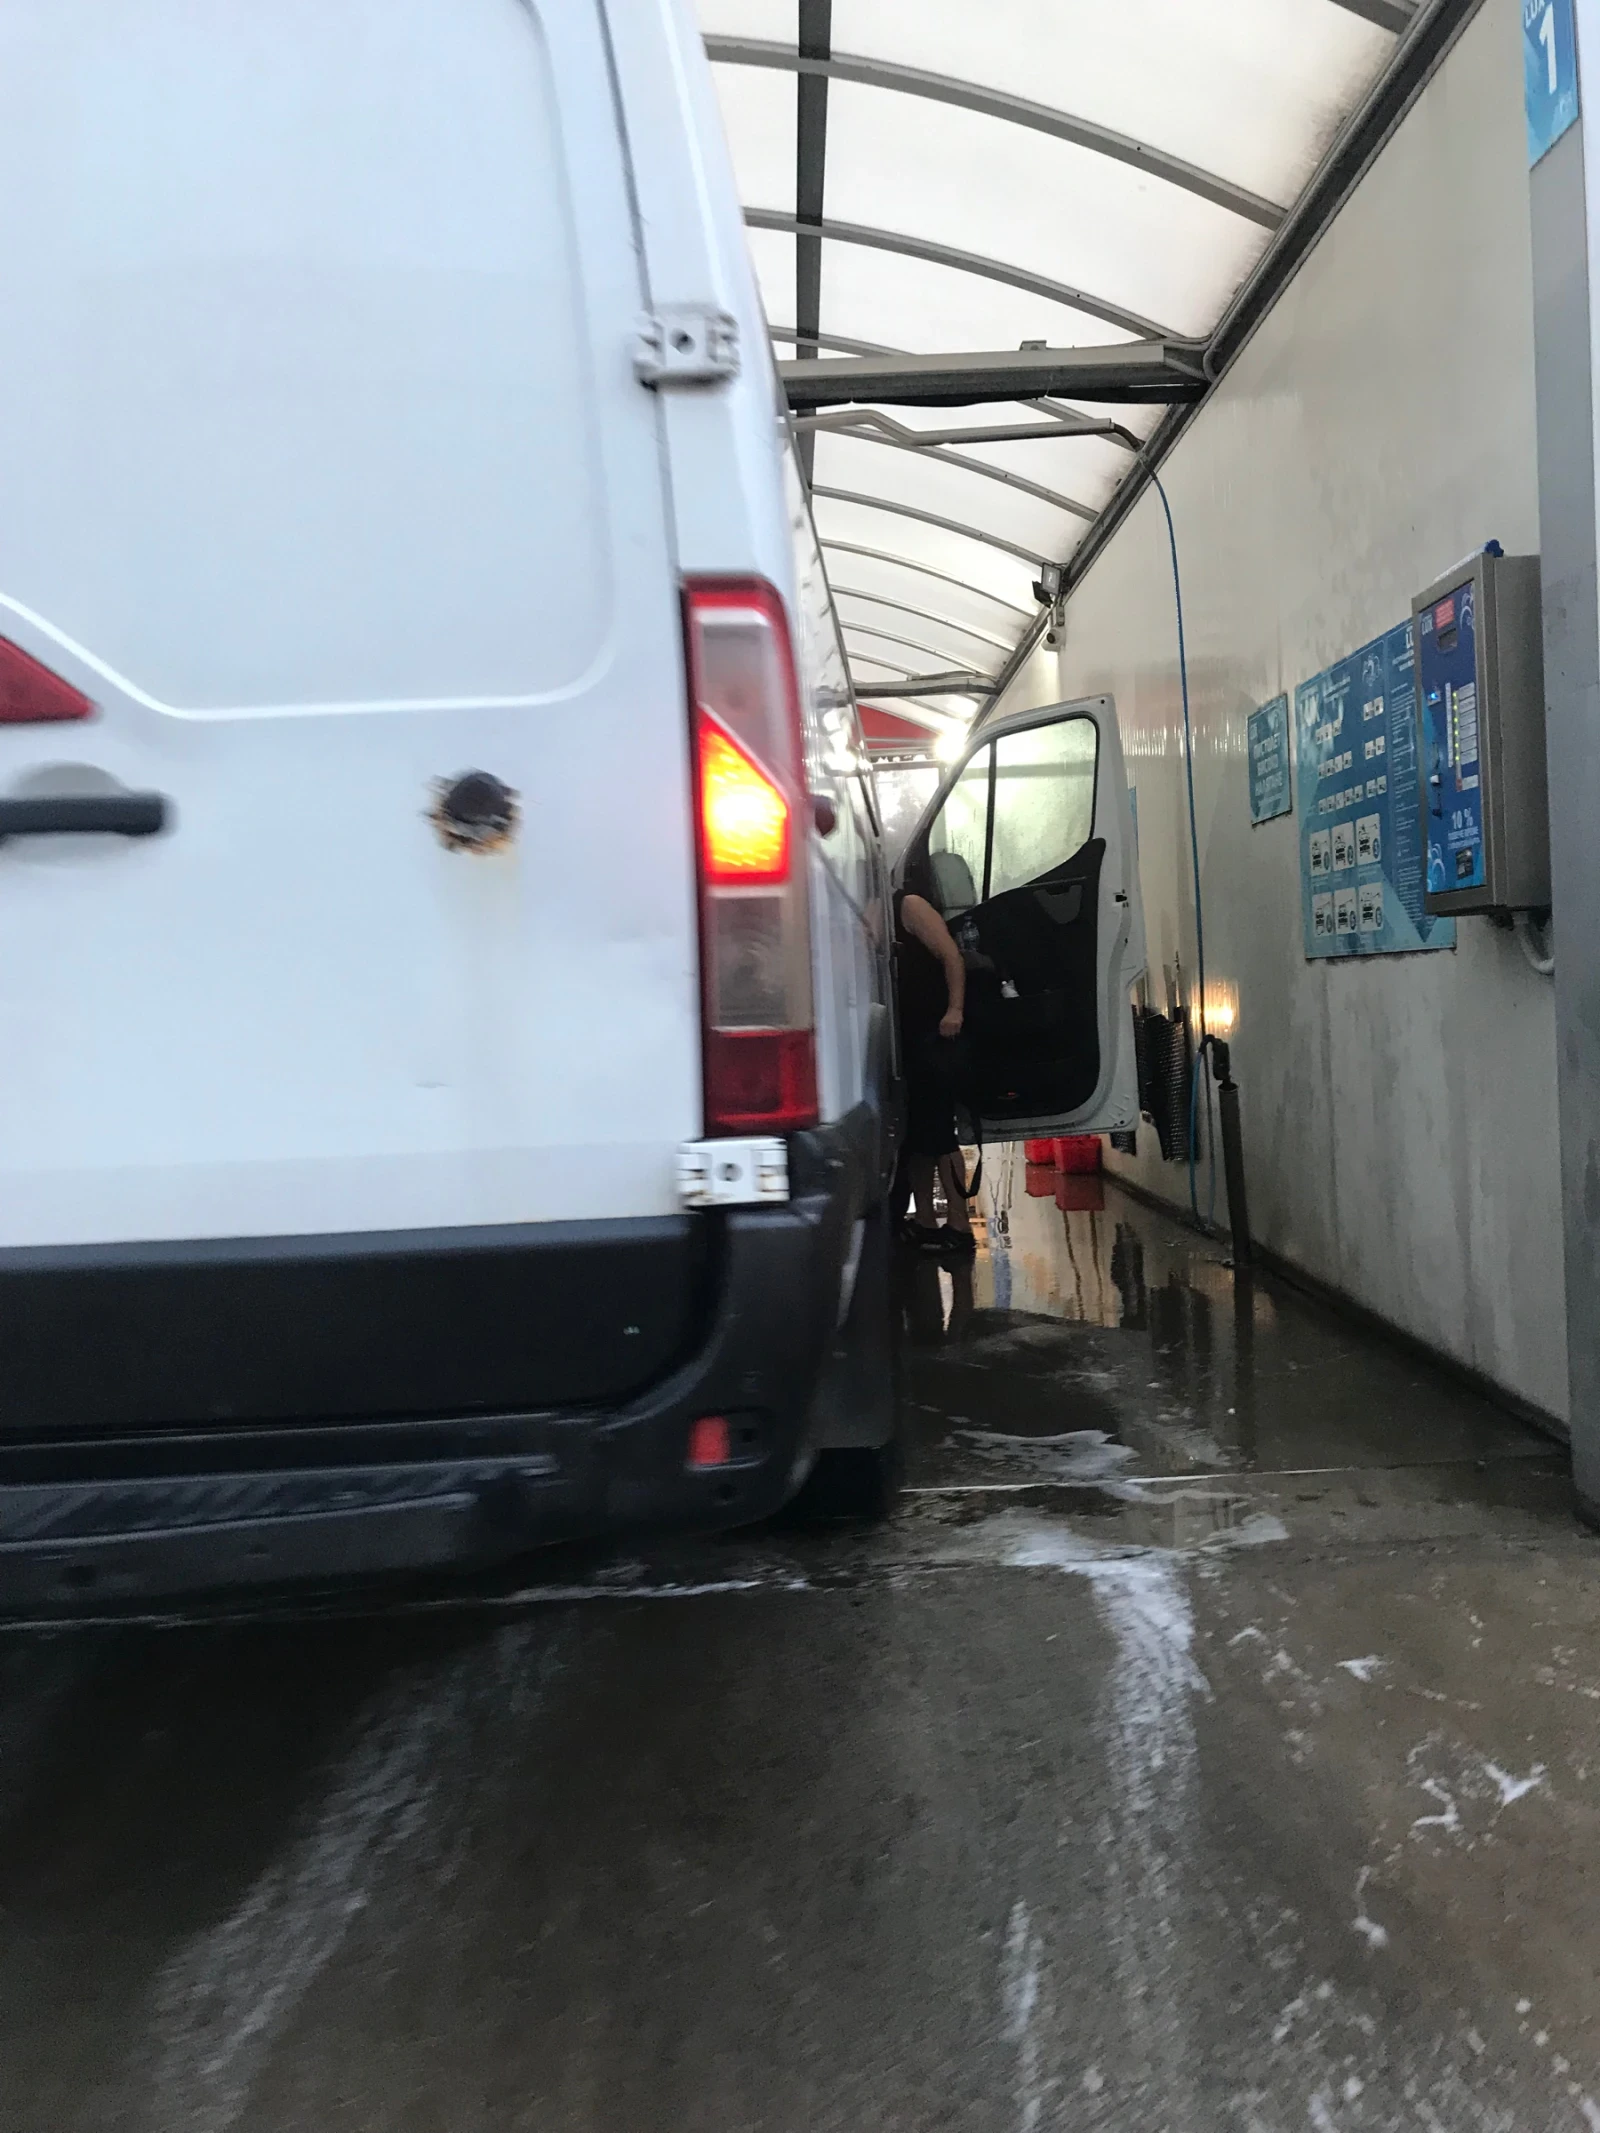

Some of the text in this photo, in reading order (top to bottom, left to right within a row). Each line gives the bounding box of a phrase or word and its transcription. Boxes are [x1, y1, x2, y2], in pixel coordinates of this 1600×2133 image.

[1525, 0, 1545, 28] LUX
[1539, 2, 1557, 94] 1
[1452, 807, 1473, 829] 10 %
